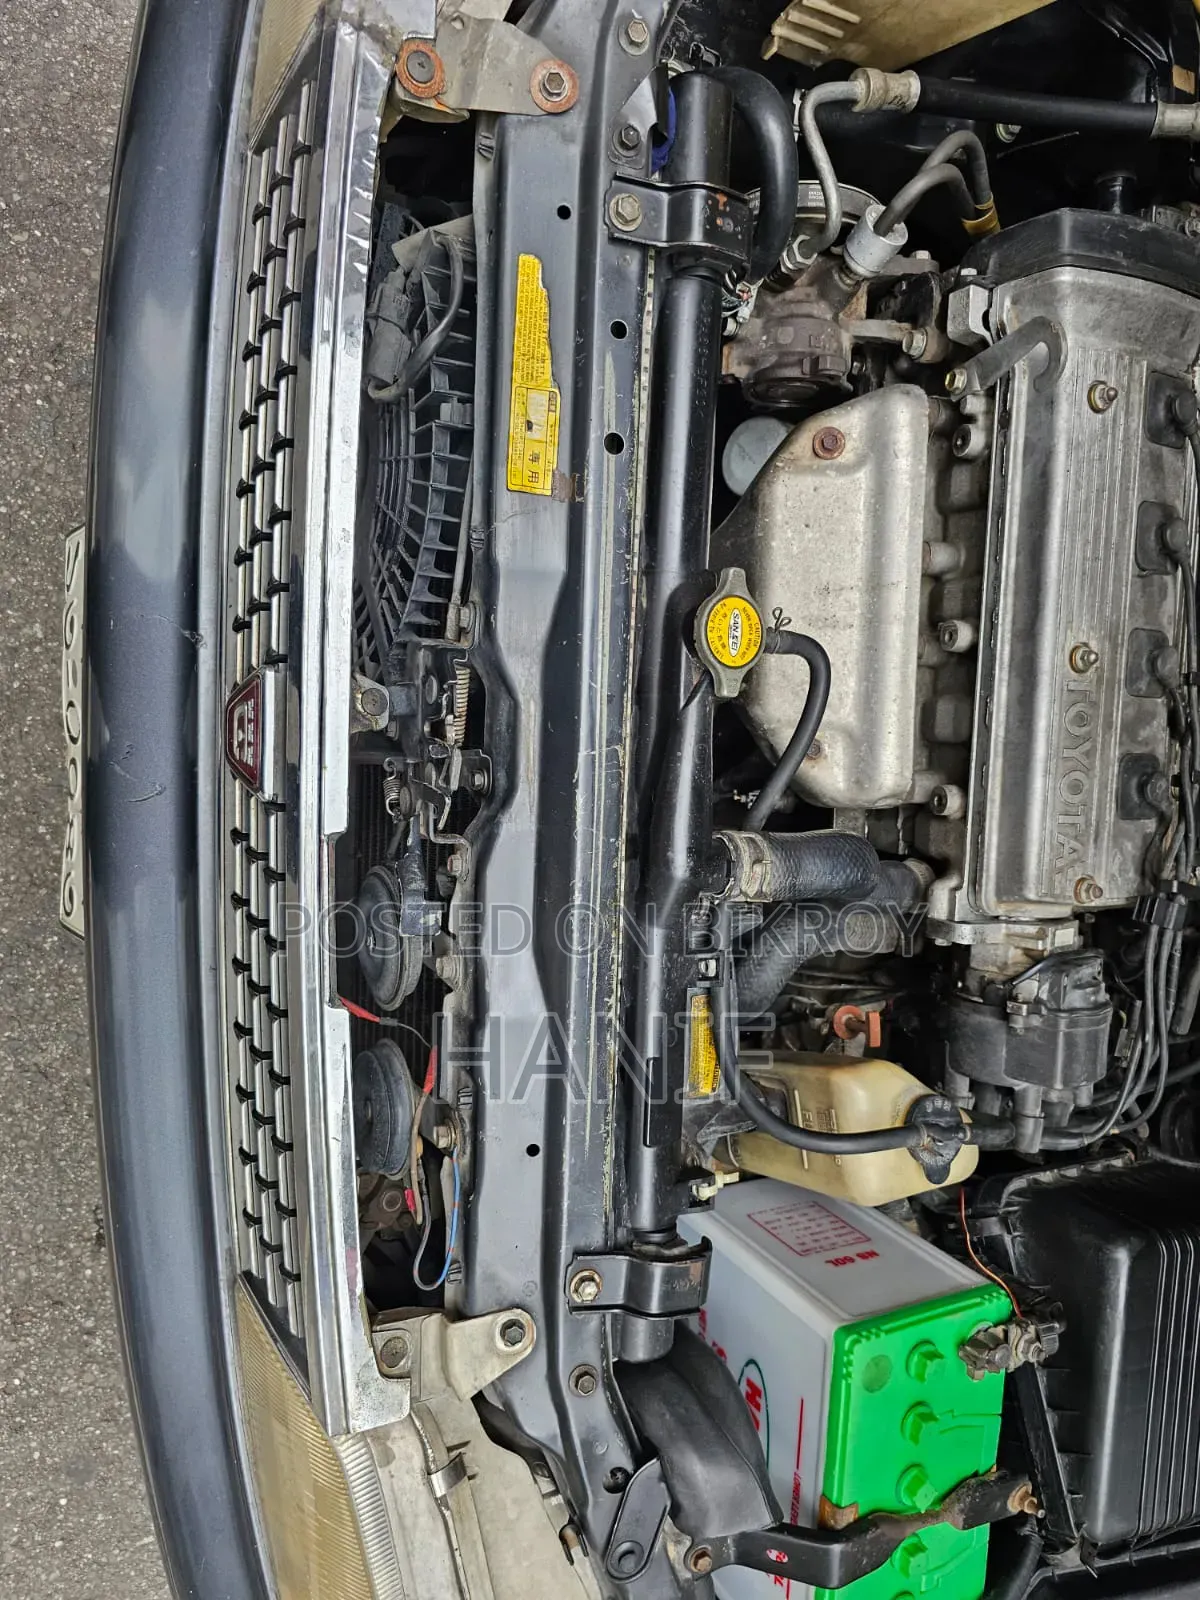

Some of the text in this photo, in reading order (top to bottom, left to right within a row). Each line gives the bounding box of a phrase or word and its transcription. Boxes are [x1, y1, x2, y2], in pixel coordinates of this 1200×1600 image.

[731, 612, 740, 651] SANKEI
[753, 622, 761, 649] CAUTION
[1055, 678, 1096, 873] TOYOTA
